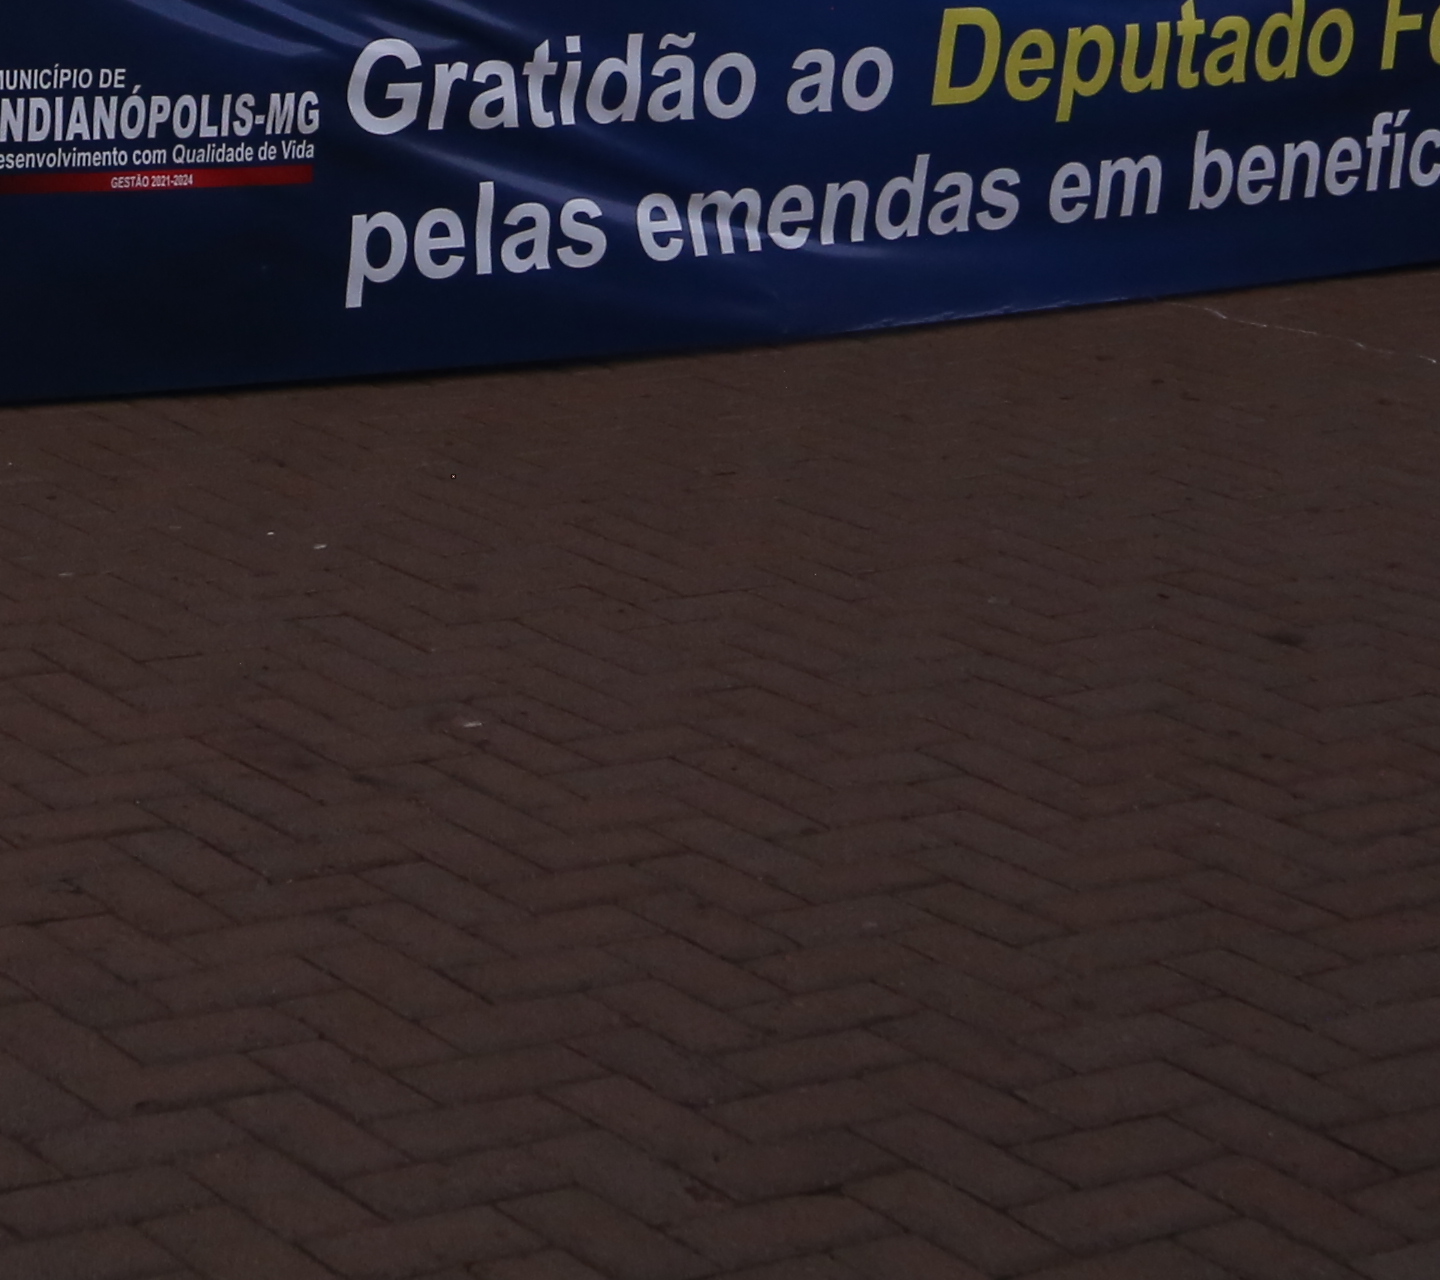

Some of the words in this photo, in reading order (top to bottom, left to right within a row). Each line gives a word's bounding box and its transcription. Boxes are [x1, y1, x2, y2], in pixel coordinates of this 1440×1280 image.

[99, 68, 127, 89] DE
[346, 30, 757, 135] Gratidão
[786, 46, 894, 115] ao
[132, 148, 167, 165] com
[172, 142, 254, 164] Qualidade
[257, 141, 277, 161] de
[281, 139, 315, 159] Vida
[110, 174, 150, 189] GESTÃO
[151, 174, 194, 187] 2021-2024
[345, 181, 608, 308] pelas
[635, 153, 1020, 262] emendas
[1049, 153, 1163, 224] em
